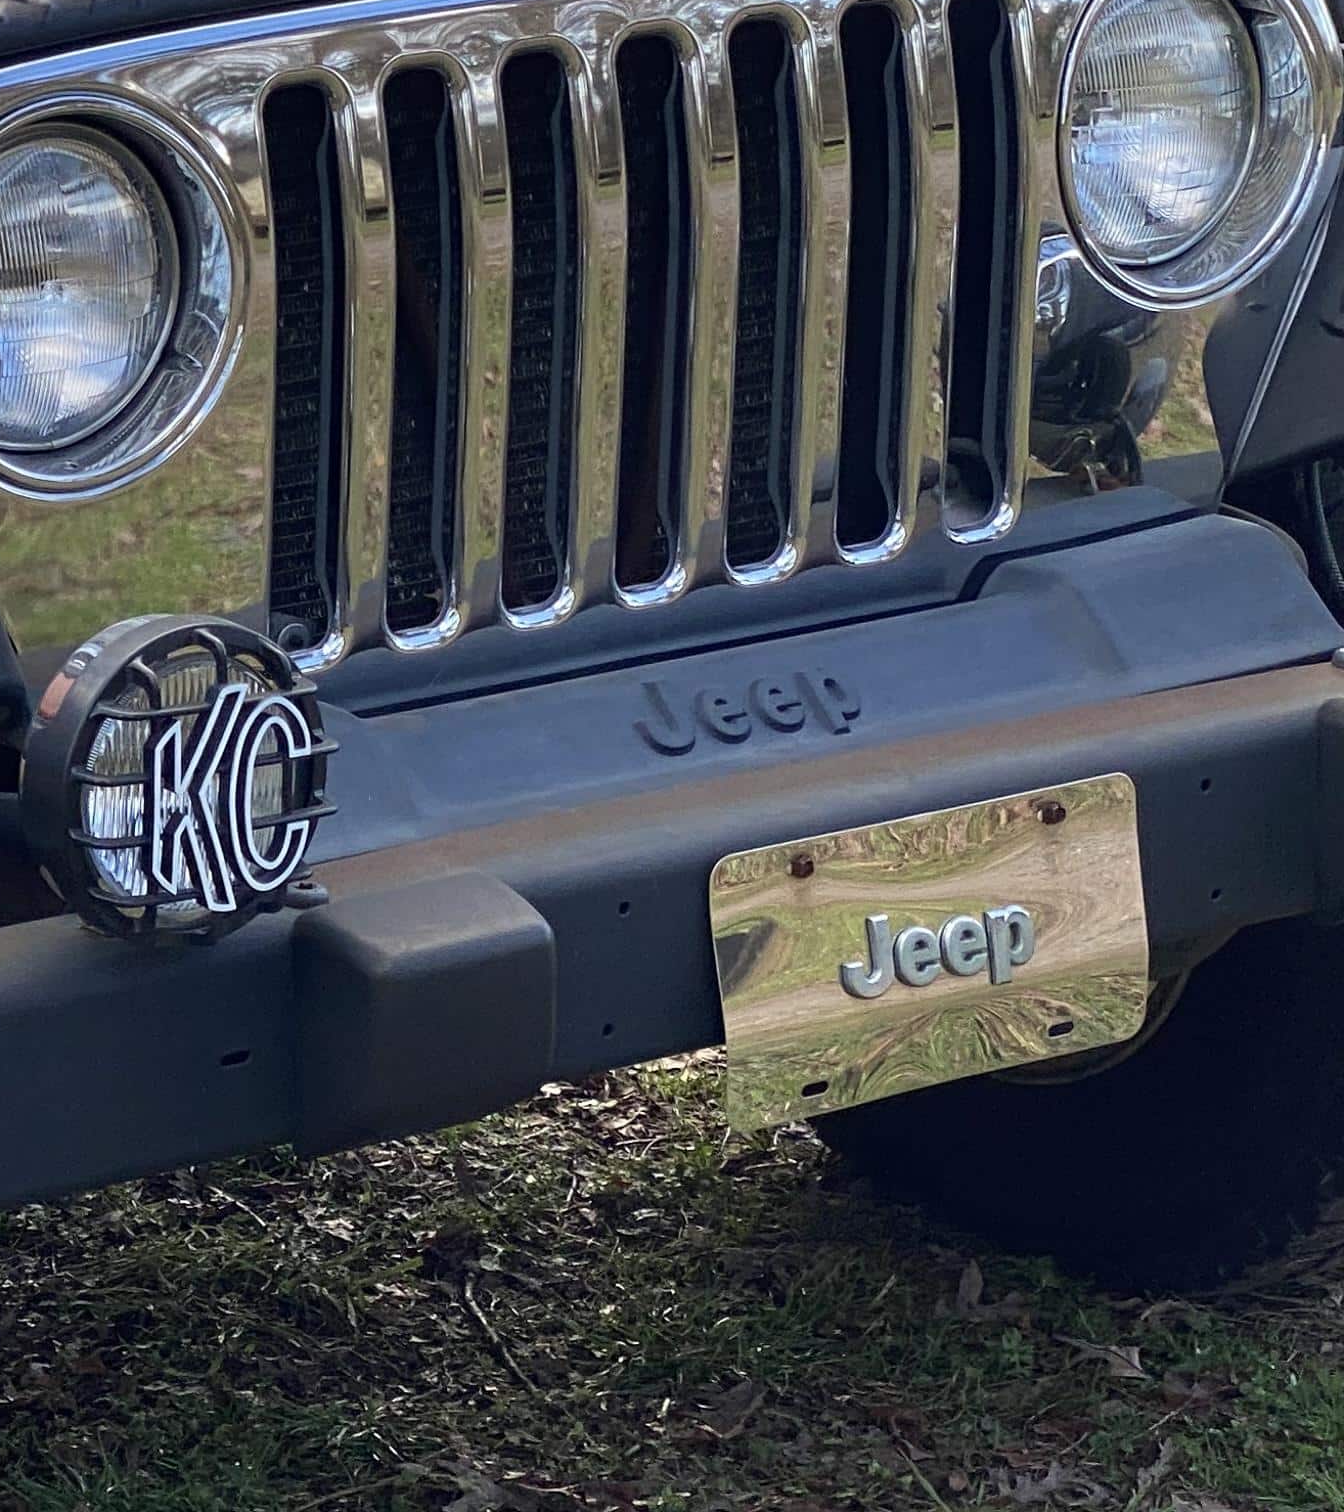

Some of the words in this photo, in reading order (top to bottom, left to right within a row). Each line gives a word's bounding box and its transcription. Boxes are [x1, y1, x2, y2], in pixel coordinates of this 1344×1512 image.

[632, 670, 861, 757] Jeep
[151, 683, 312, 912] KC
[838, 904, 1036, 999] Jeep
